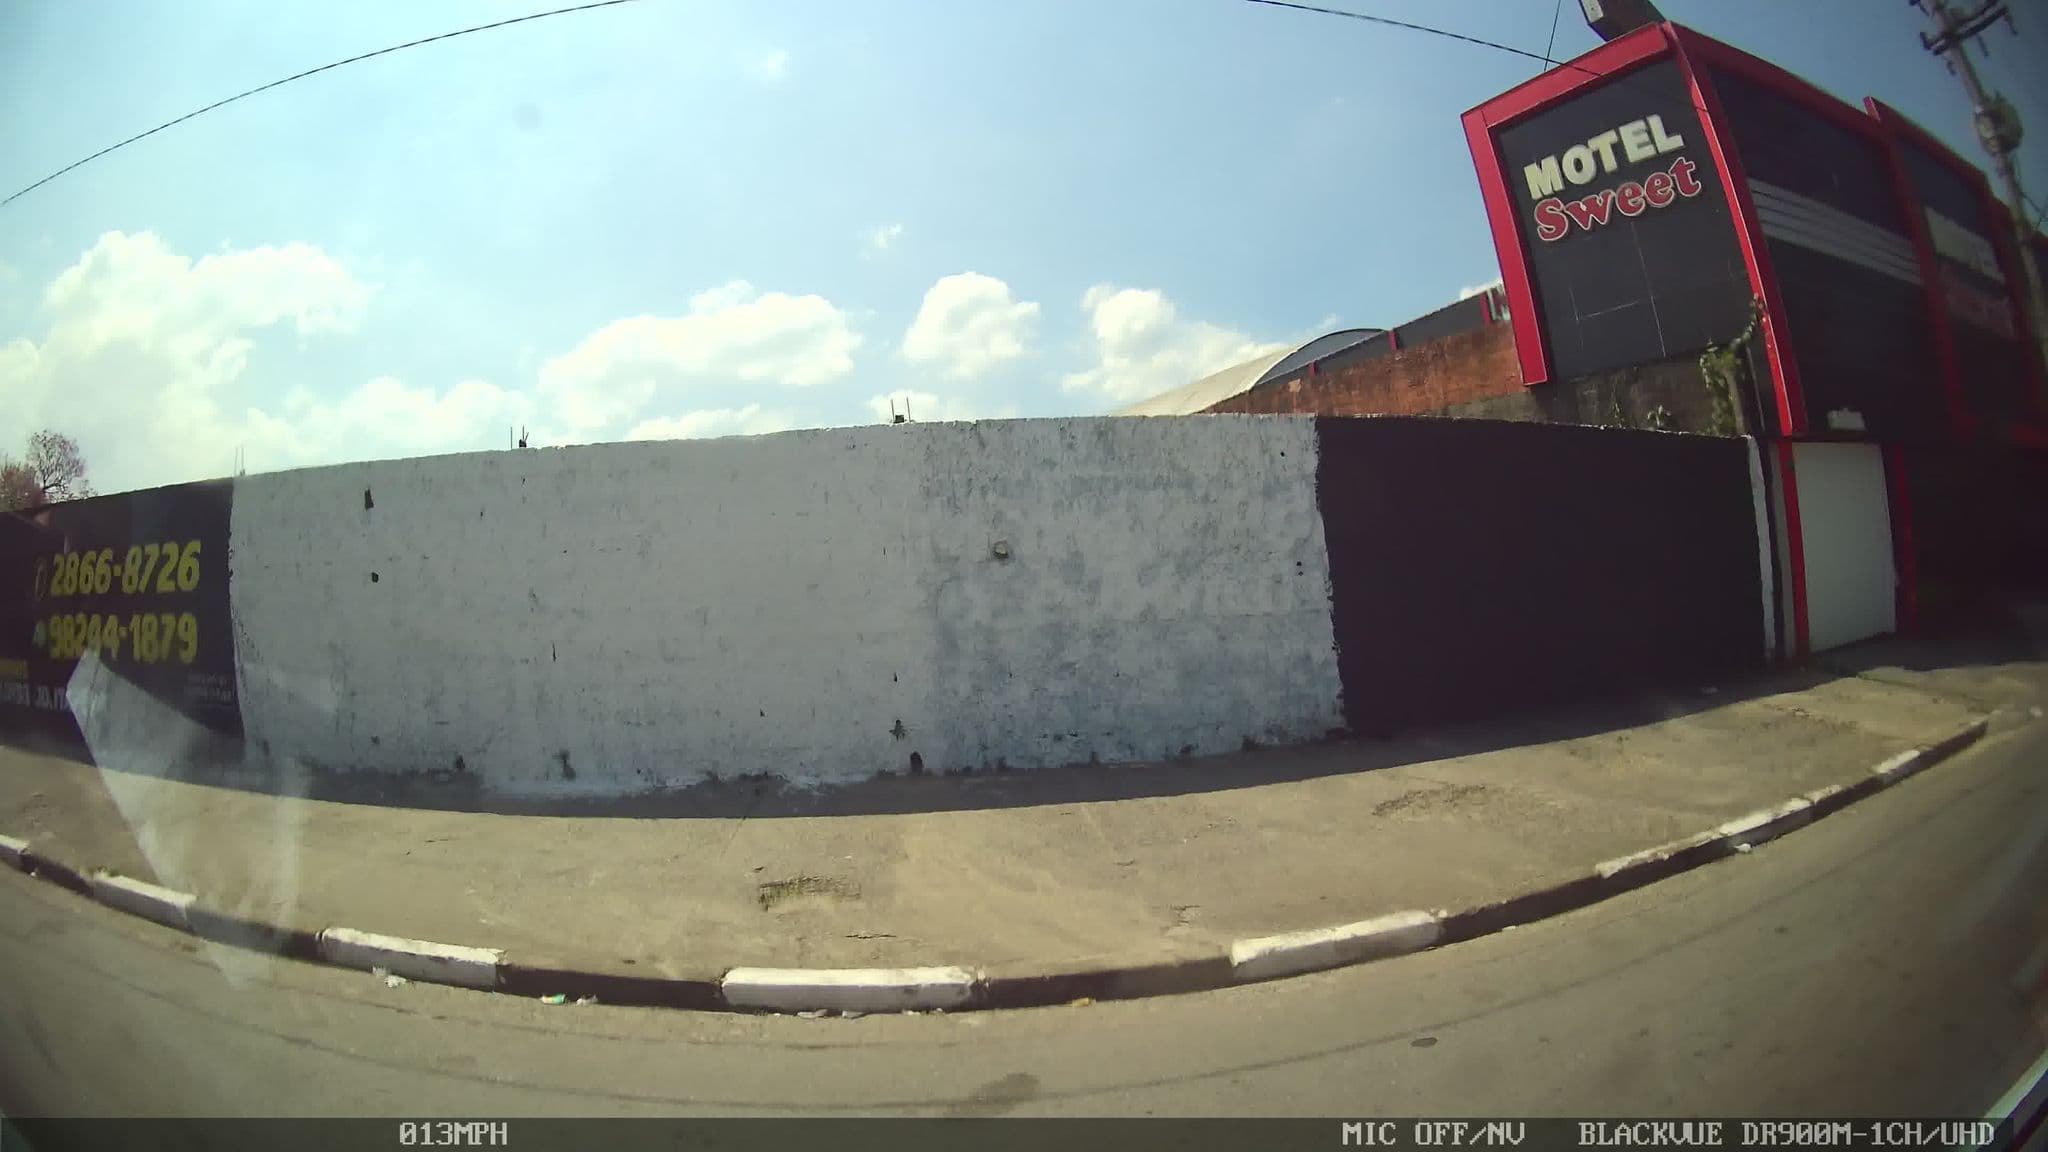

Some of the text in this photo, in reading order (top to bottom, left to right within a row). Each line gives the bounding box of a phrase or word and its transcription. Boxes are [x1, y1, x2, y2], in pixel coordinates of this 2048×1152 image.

[1524, 114, 1685, 200] MOTEL
[1534, 157, 1702, 241] Sweet
[50, 539, 201, 596] 2866-8726
